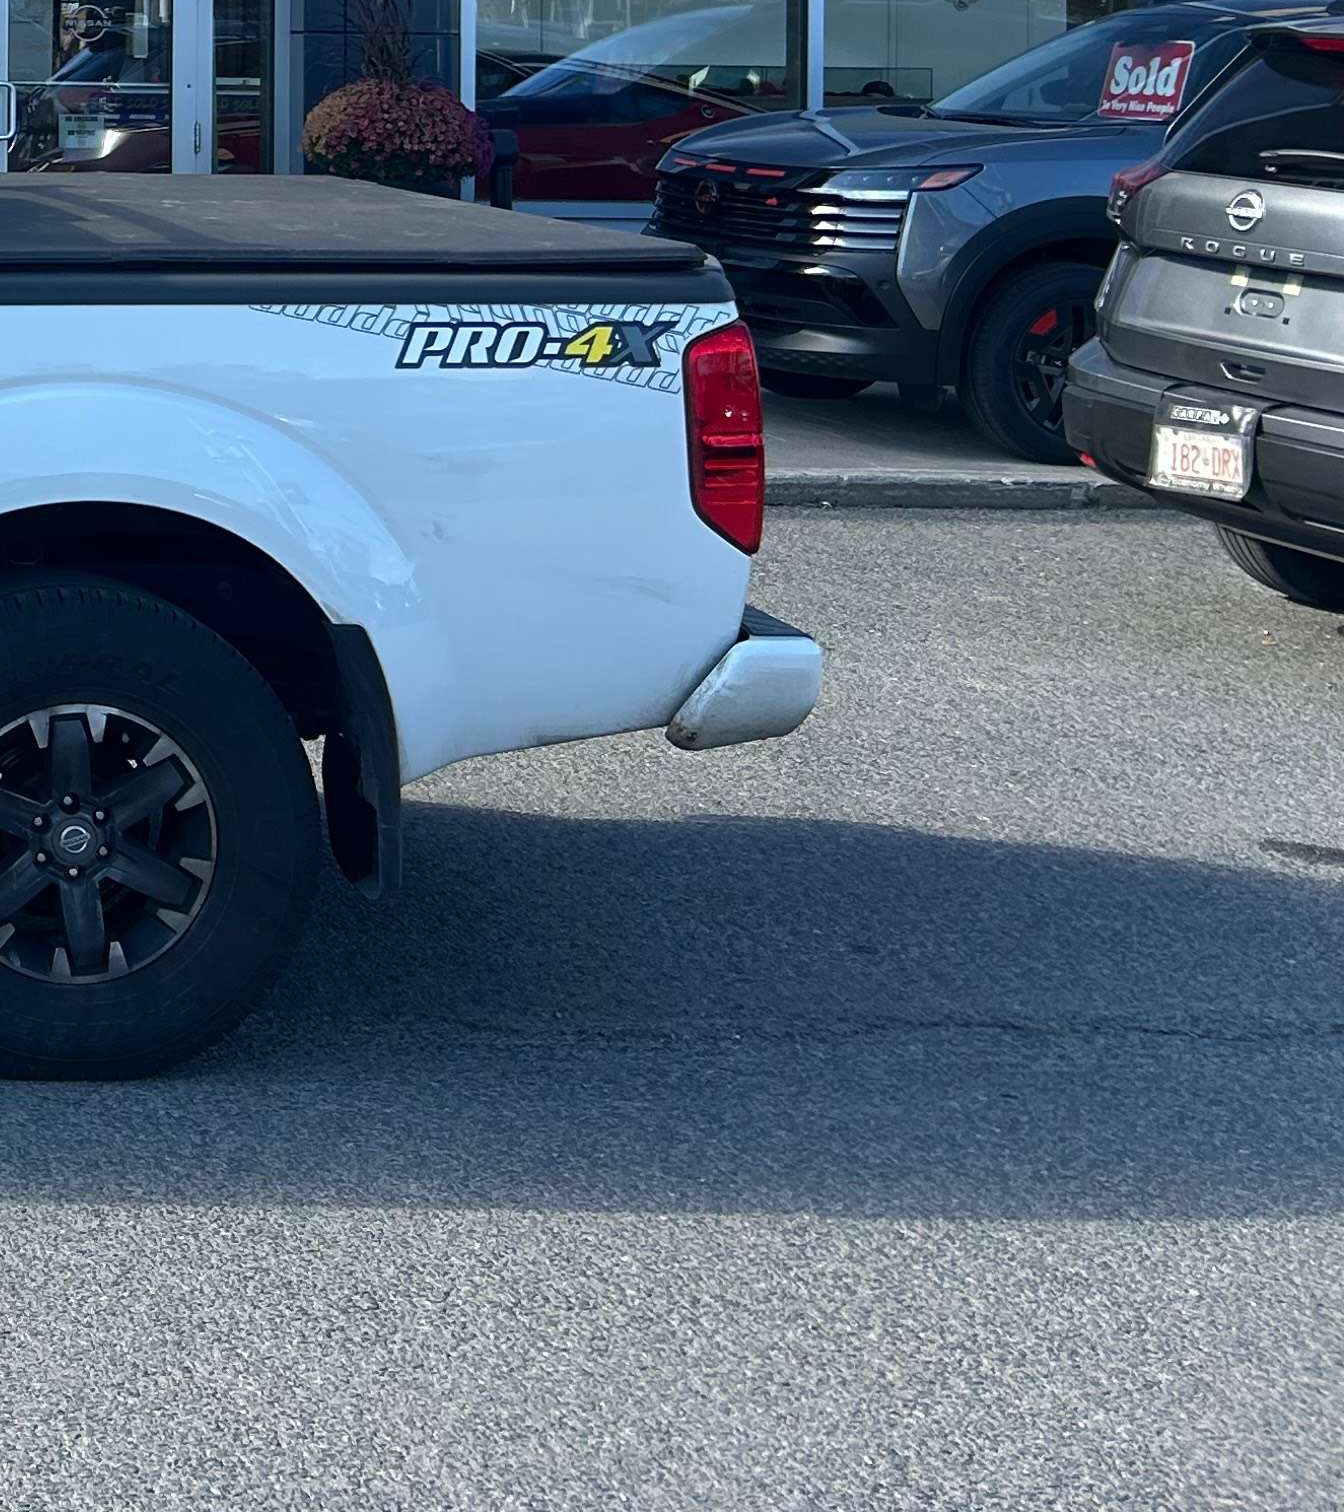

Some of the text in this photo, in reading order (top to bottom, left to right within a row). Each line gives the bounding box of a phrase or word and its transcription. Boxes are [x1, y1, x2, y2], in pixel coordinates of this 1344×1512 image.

[1110, 55, 1183, 97] Sold
[1180, 236, 1305, 266] ROGUE
[395, 320, 680, 369] PRO-4X
[1171, 443, 1241, 479] 182 DRX
